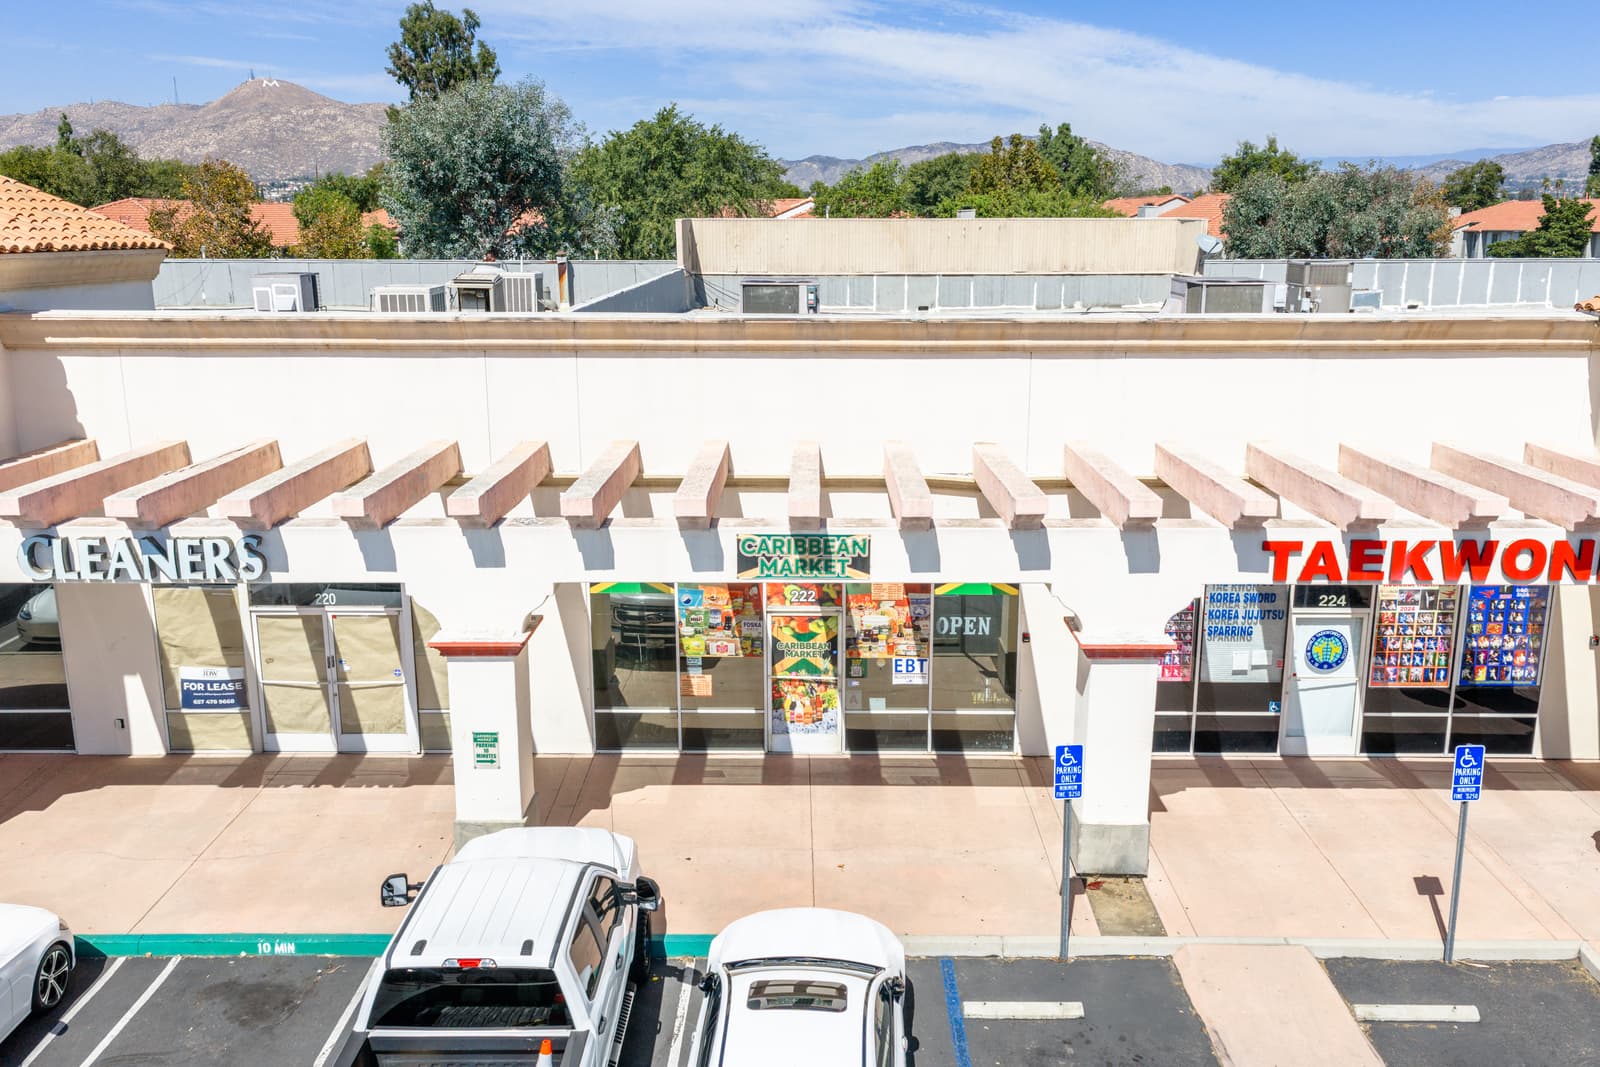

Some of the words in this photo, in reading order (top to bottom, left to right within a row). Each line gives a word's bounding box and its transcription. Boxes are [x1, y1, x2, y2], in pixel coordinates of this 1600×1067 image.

[740, 537, 868, 555] CARIBBEAN
[17, 534, 268, 581] CLEANERS
[1262, 538, 1600, 582] TAEKWON
[759, 557, 850, 576] MARKET
[315, 593, 336, 605] 220
[791, 590, 816, 602] 222
[1209, 592, 1241, 603] KOREA
[1243, 592, 1277, 603] SWORD
[1318, 594, 1347, 607] 224
[1208, 609, 1240, 620] KOREA
[1241, 609, 1285, 620] JUJUTSU
[935, 616, 992, 635] OPEN
[1207, 625, 1254, 637] SPARRING
[776, 641, 831, 650] CARIBBEAN
[785, 650, 824, 658] MARKET
[894, 658, 928, 673] EBT
[183, 682, 205, 690] FOR
[207, 682, 243, 690] LEASE
[1056, 766, 1081, 774] PARKING
[1061, 775, 1076, 783] ONLY
[1460, 776, 1475, 784] ONLY
[257, 942, 271, 954] 10
[274, 942, 295, 954] MIN
